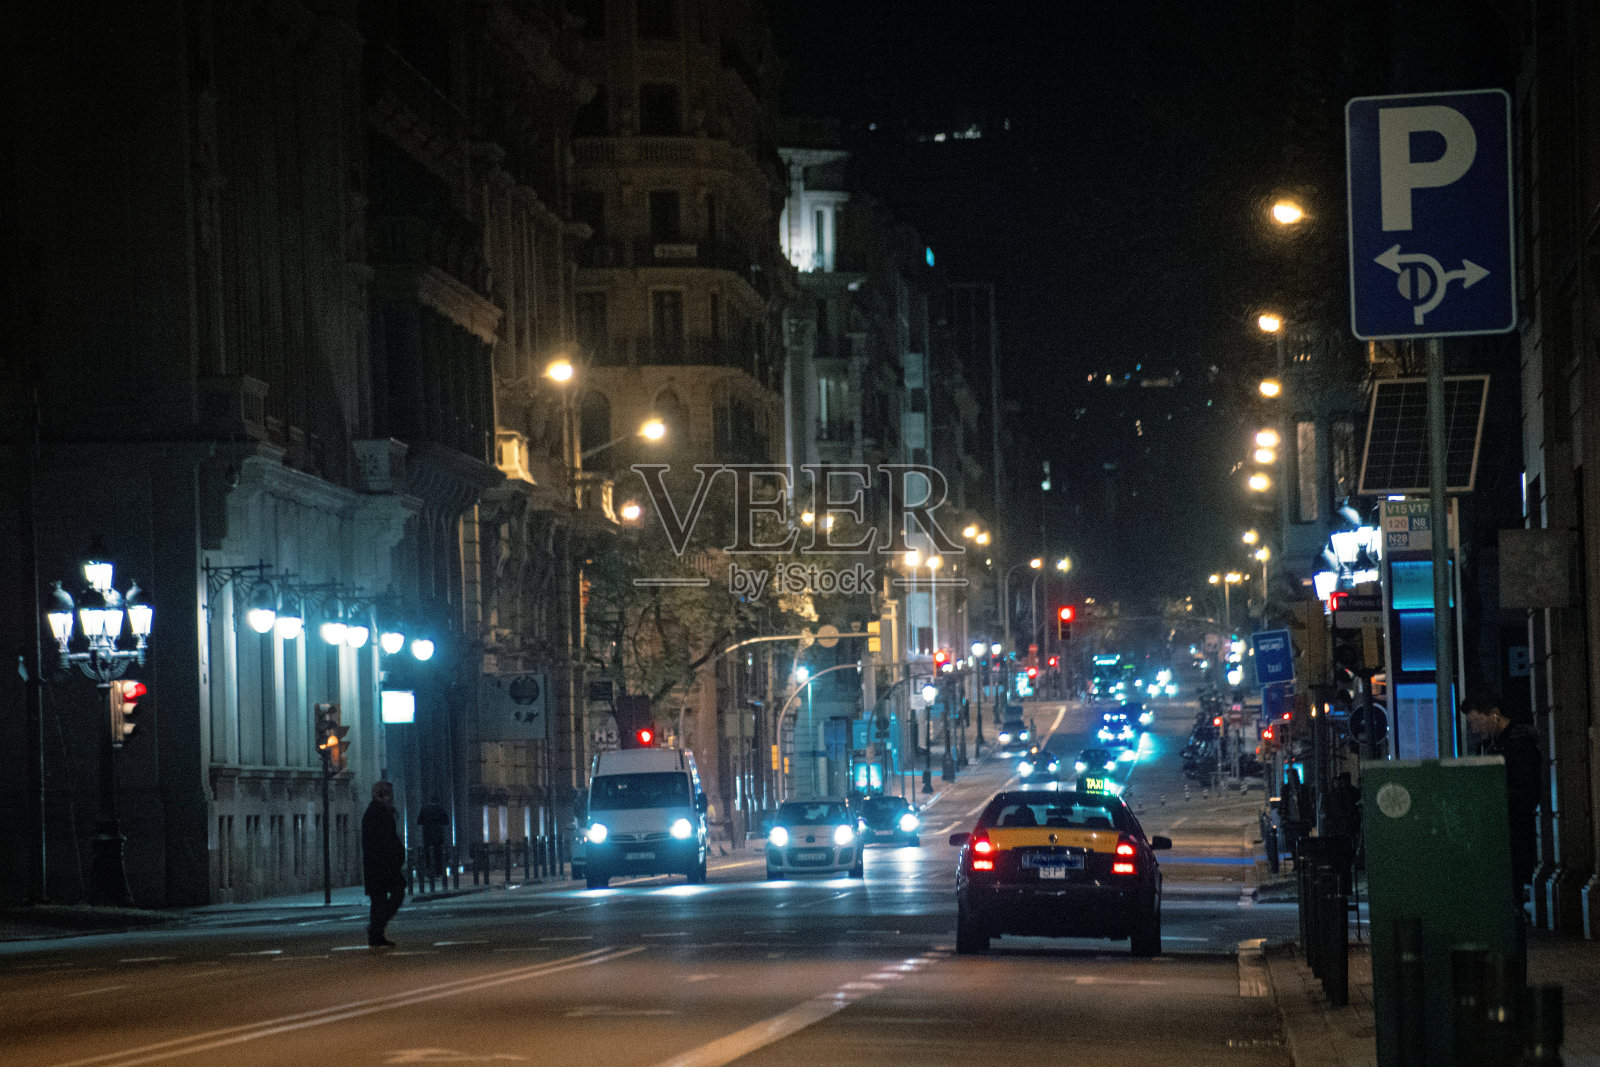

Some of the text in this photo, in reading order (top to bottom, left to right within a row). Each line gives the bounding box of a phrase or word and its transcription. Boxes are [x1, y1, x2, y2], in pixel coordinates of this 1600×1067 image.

[1378, 104, 1477, 232] P
[1387, 503, 1429, 514] V15 V17
[1388, 519, 1407, 528] 120
[1412, 518, 1426, 527] N8
[1388, 533, 1408, 543] N28
[1267, 662, 1282, 673] taxi
[1086, 777, 1103, 790] TAXI
